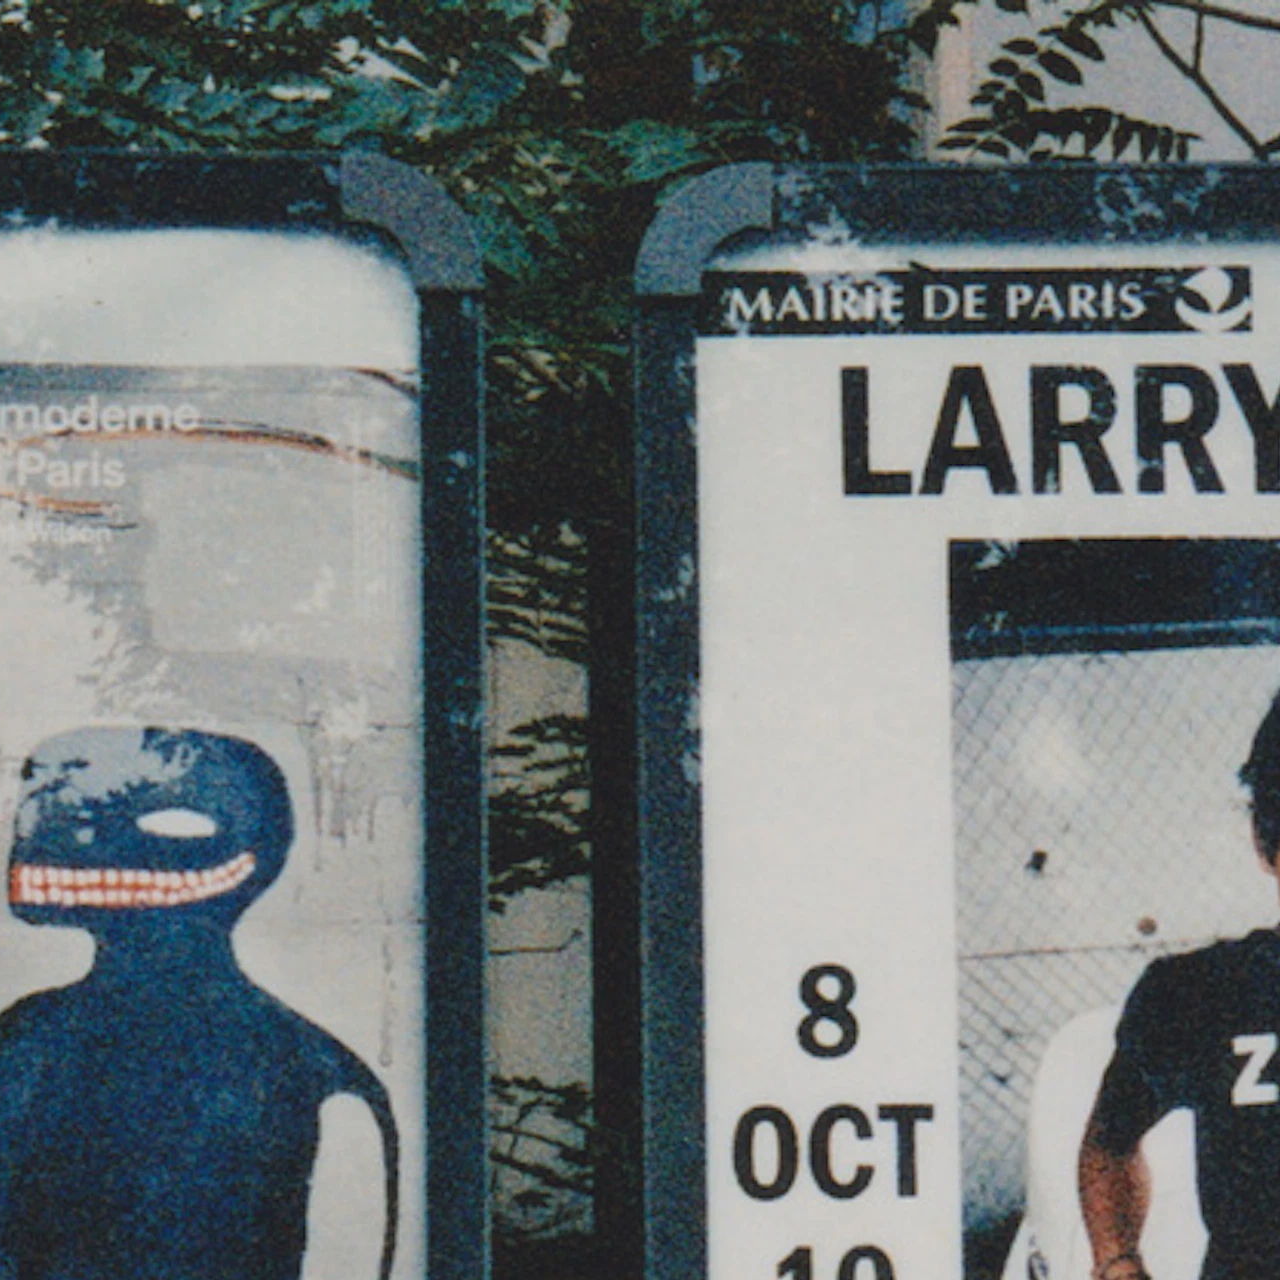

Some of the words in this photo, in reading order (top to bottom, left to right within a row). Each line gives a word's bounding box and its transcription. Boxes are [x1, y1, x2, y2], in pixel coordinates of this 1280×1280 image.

[727, 283, 904, 323] MAIRIE
[923, 284, 988, 322] DE
[1006, 281, 1147, 322] PARIS
[0, 394, 201, 432] moderne
[18, 448, 126, 488] Paris
[796, 962, 860, 1060] 8
[732, 1103, 935, 1202] OCT
